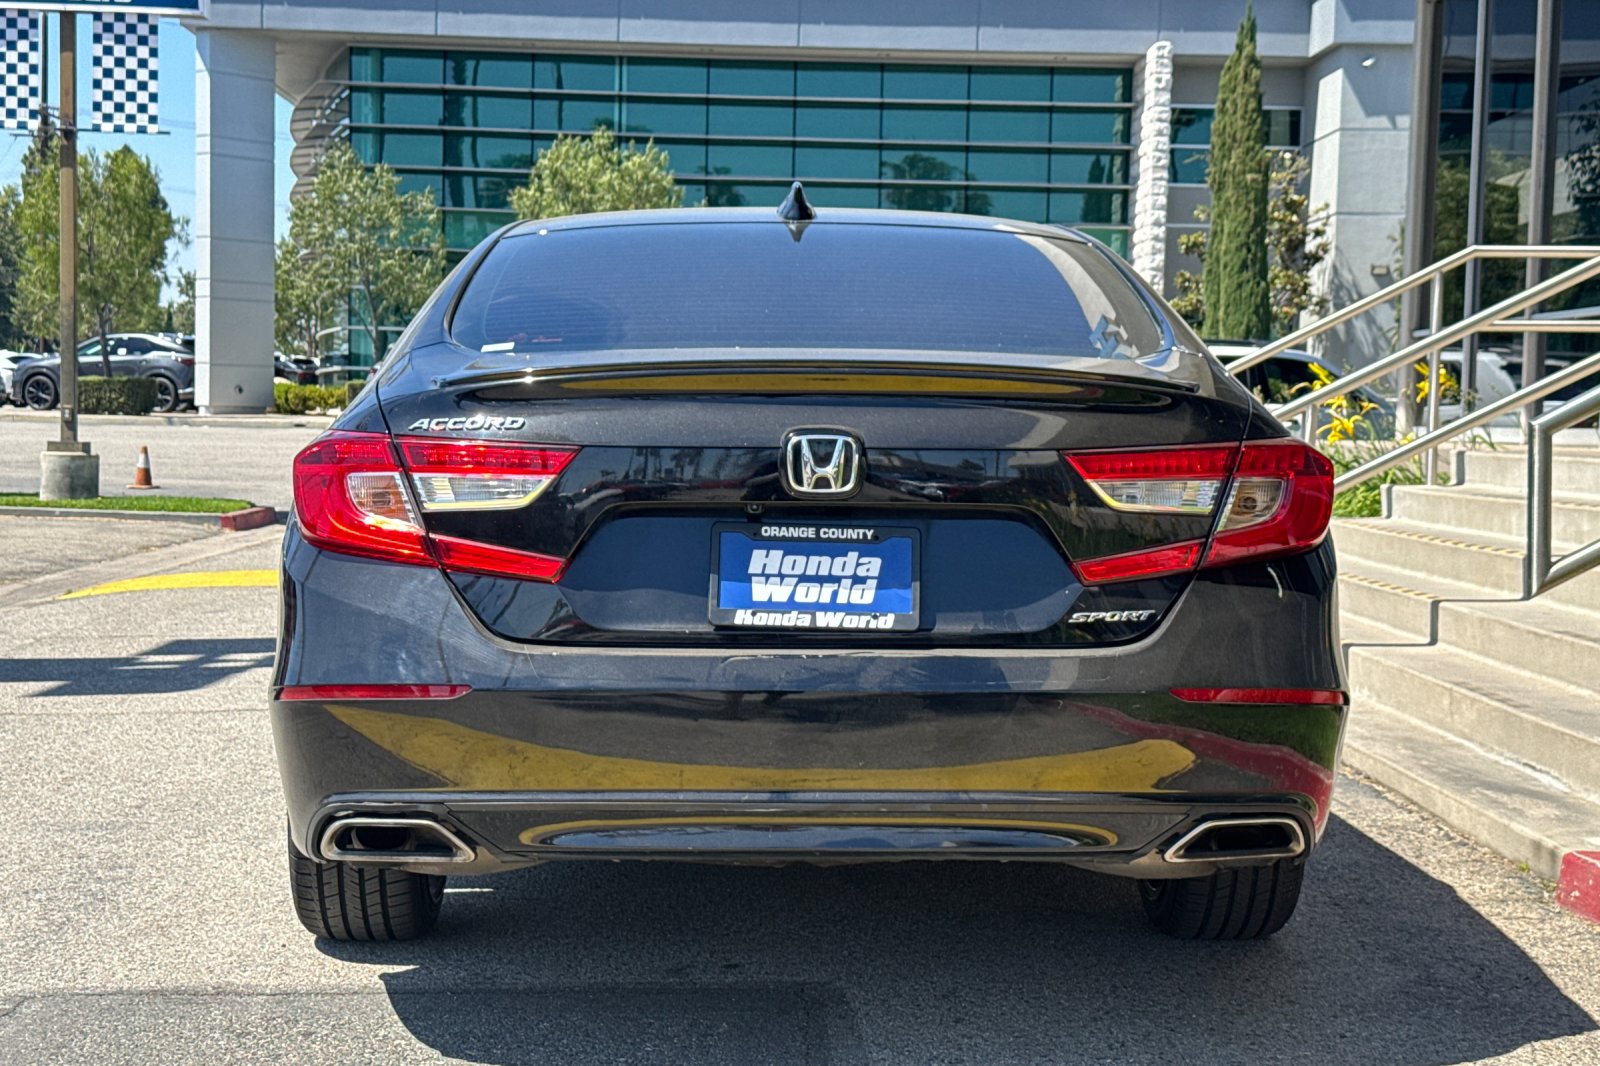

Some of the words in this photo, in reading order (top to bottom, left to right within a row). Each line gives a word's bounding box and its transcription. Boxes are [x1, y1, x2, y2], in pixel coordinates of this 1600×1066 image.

[408, 415, 526, 431] ACCORD
[761, 526, 816, 538] ORANGE
[820, 528, 874, 540] COUNTY
[748, 549, 882, 577] Honda
[751, 576, 878, 604] World
[734, 609, 811, 626] Honda
[815, 611, 895, 629] World
[1068, 610, 1156, 623] SPORT
